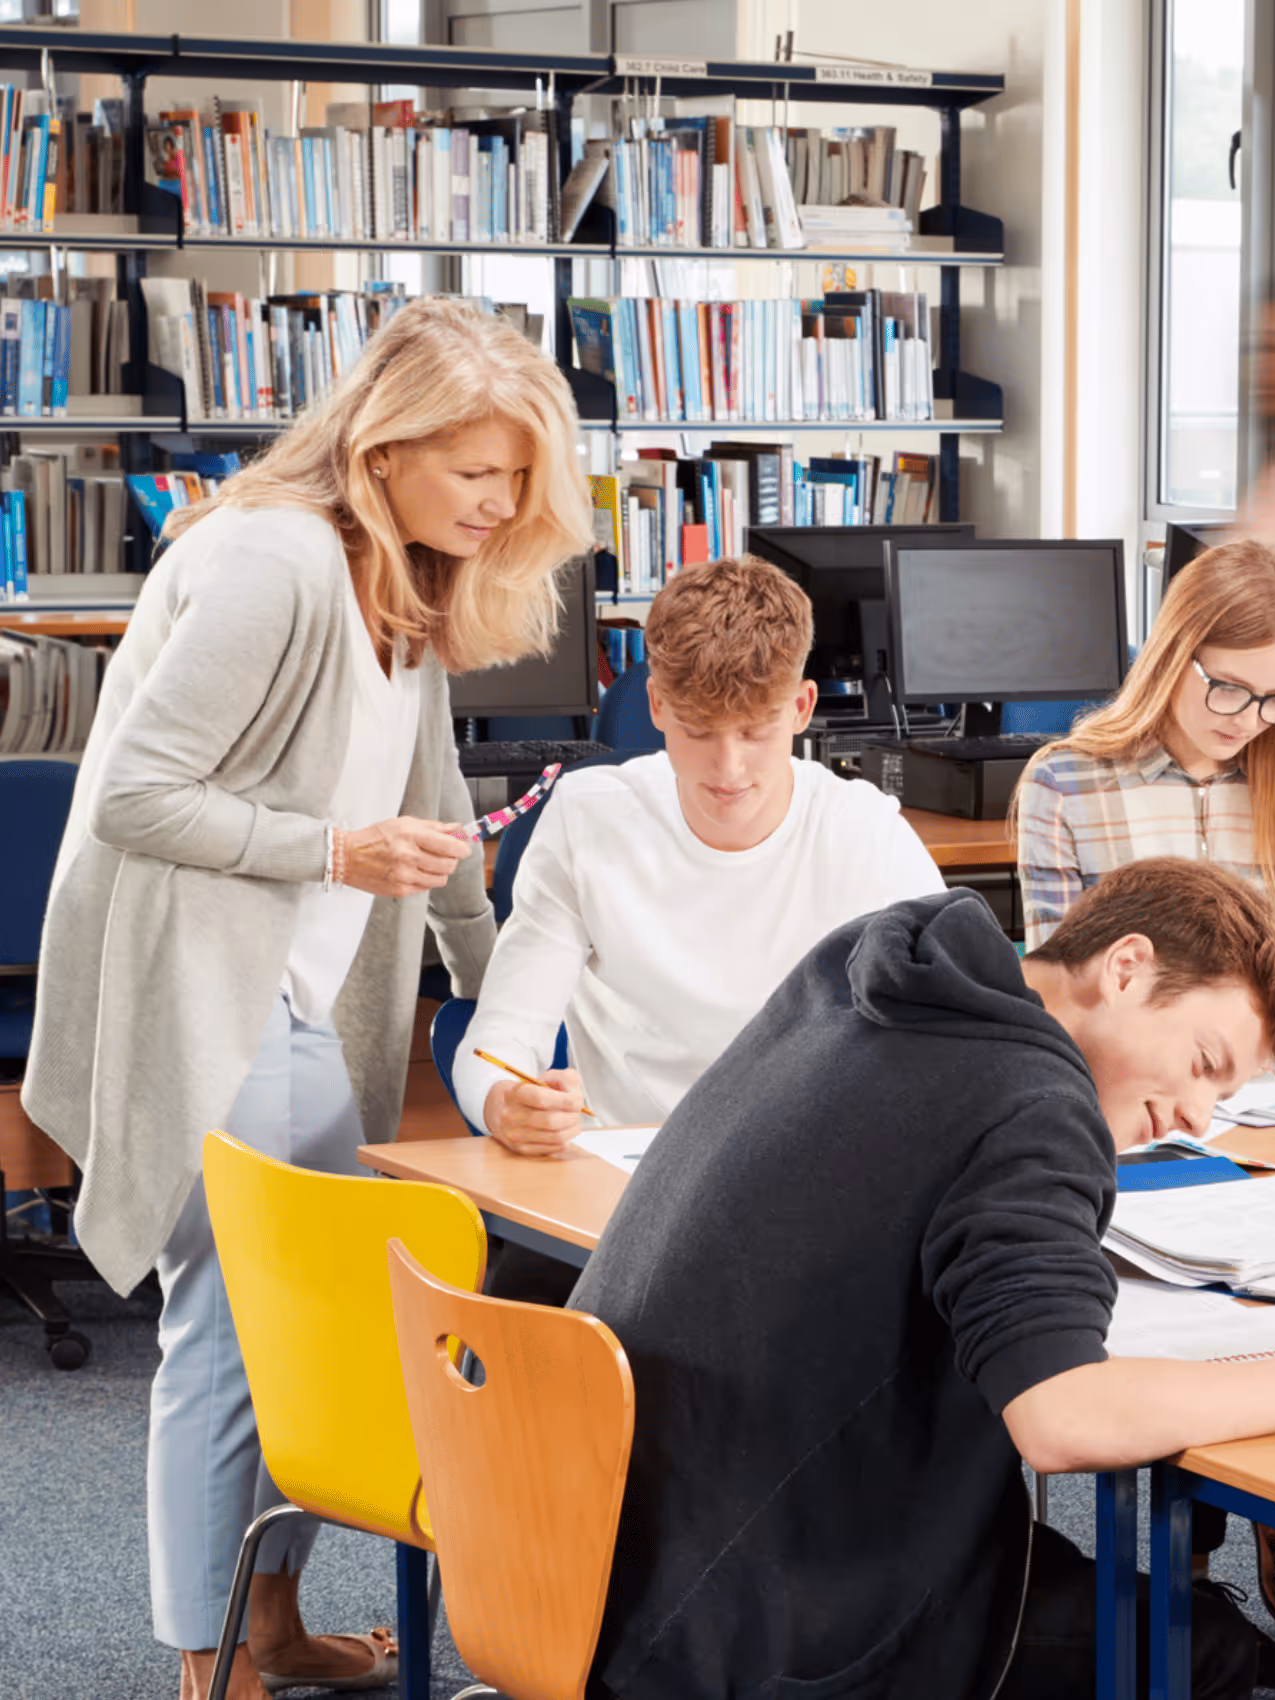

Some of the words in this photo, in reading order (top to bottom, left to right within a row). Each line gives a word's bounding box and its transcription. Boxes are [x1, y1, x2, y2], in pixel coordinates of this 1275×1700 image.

[653, 62, 680, 73] Child
[681, 63, 706, 73] Care
[853, 70, 884, 80] Health
[886, 72, 894, 81] &
[897, 72, 928, 84] Safety
